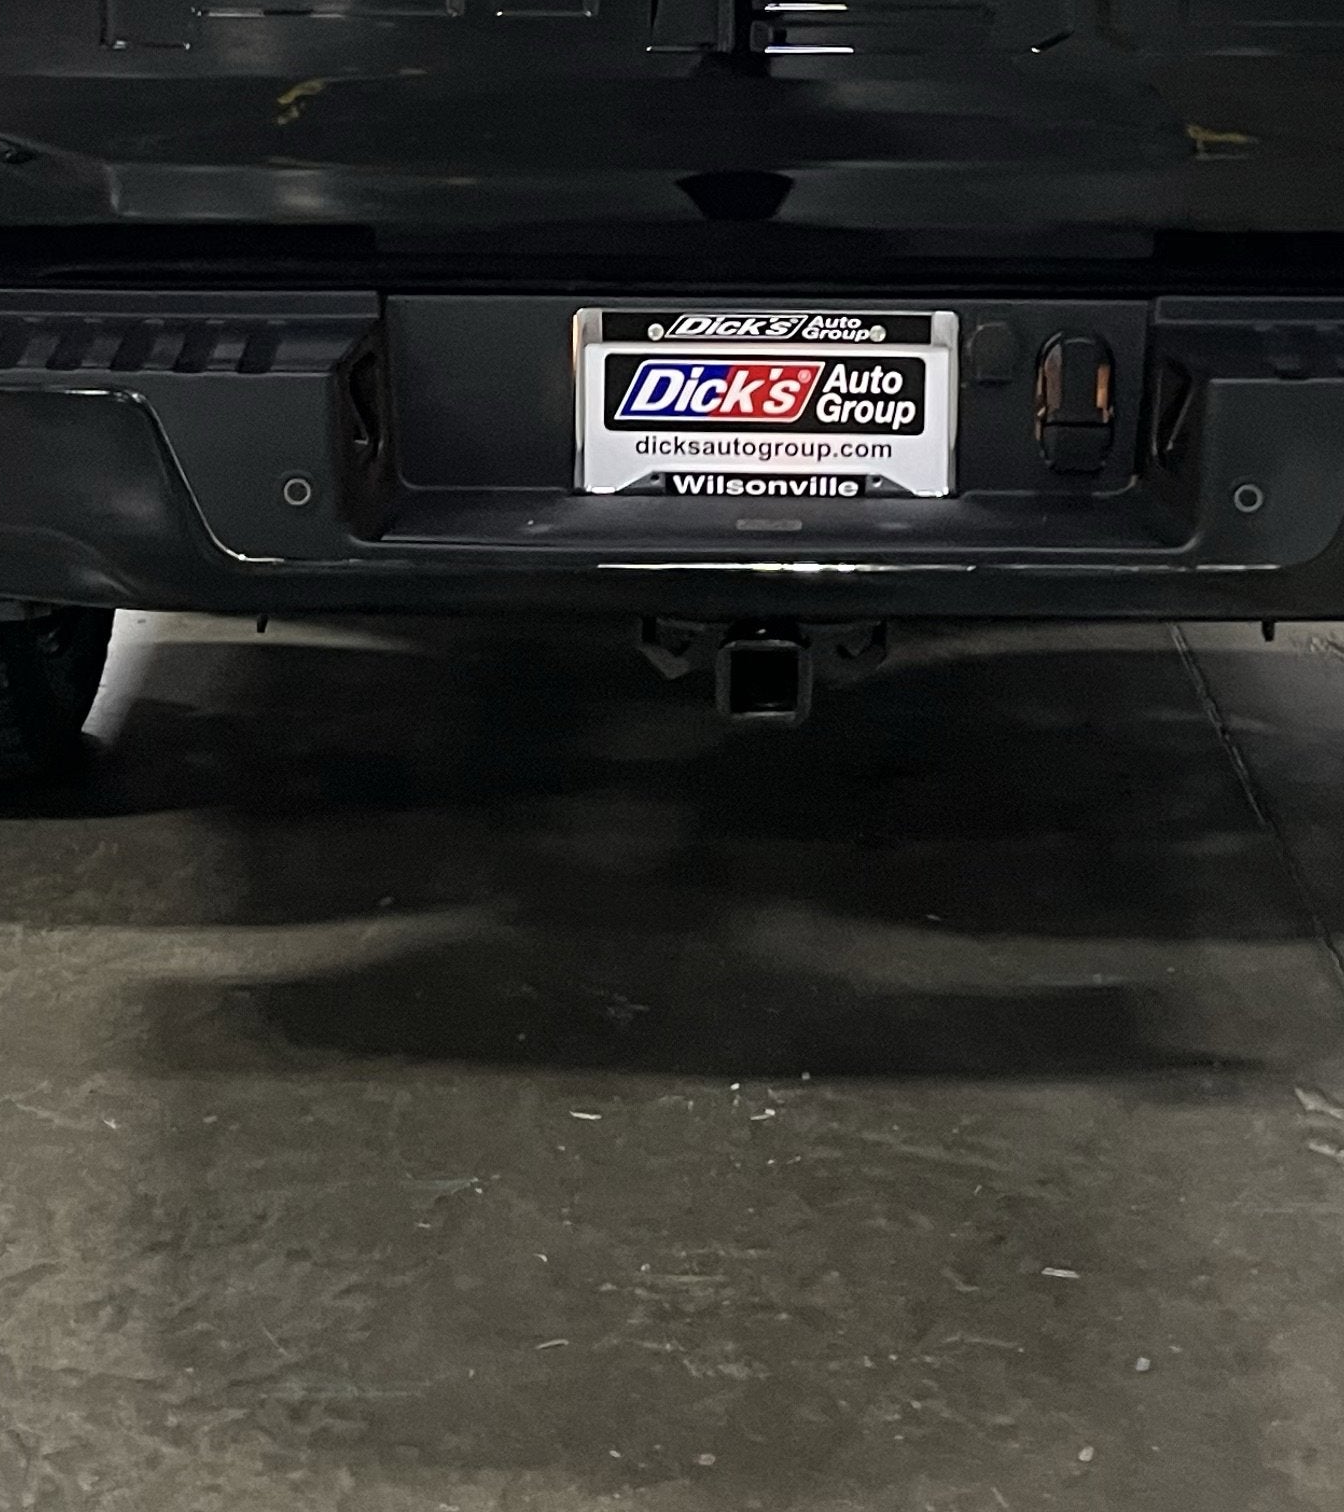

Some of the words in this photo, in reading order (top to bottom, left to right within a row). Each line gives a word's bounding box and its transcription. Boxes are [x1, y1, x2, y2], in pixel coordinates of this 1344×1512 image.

[807, 315, 862, 329] Auto
[802, 327, 871, 342] Group
[630, 366, 801, 414] Dick's
[822, 363, 904, 394] Auto
[815, 392, 916, 430] Group
[635, 436, 893, 462] dicksautogroup.com
[672, 474, 860, 497] Wilsonville
